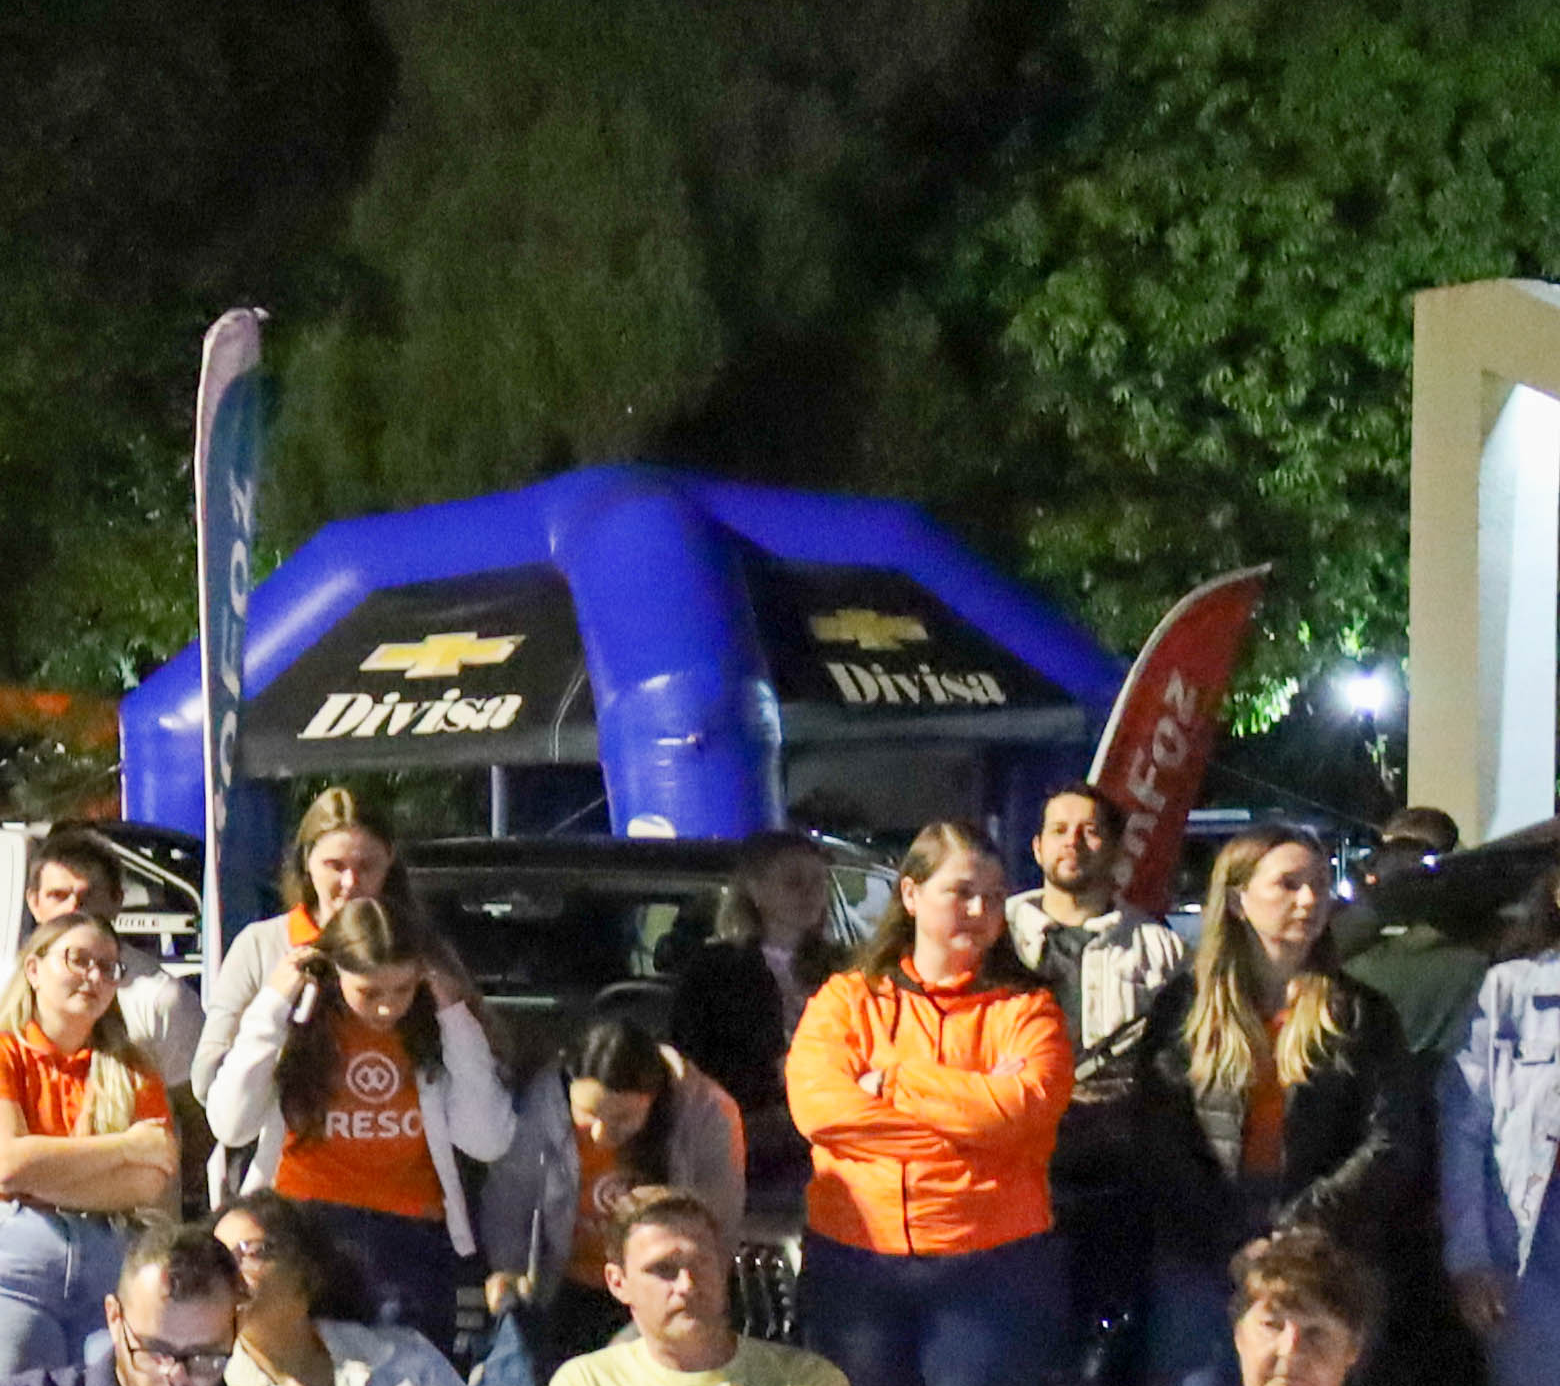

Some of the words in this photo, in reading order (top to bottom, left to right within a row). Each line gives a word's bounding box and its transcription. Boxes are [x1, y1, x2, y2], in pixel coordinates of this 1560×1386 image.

[827, 662, 1007, 706] Divisa
[297, 686, 524, 741] Divisa
[325, 1109, 424, 1140] RESO
